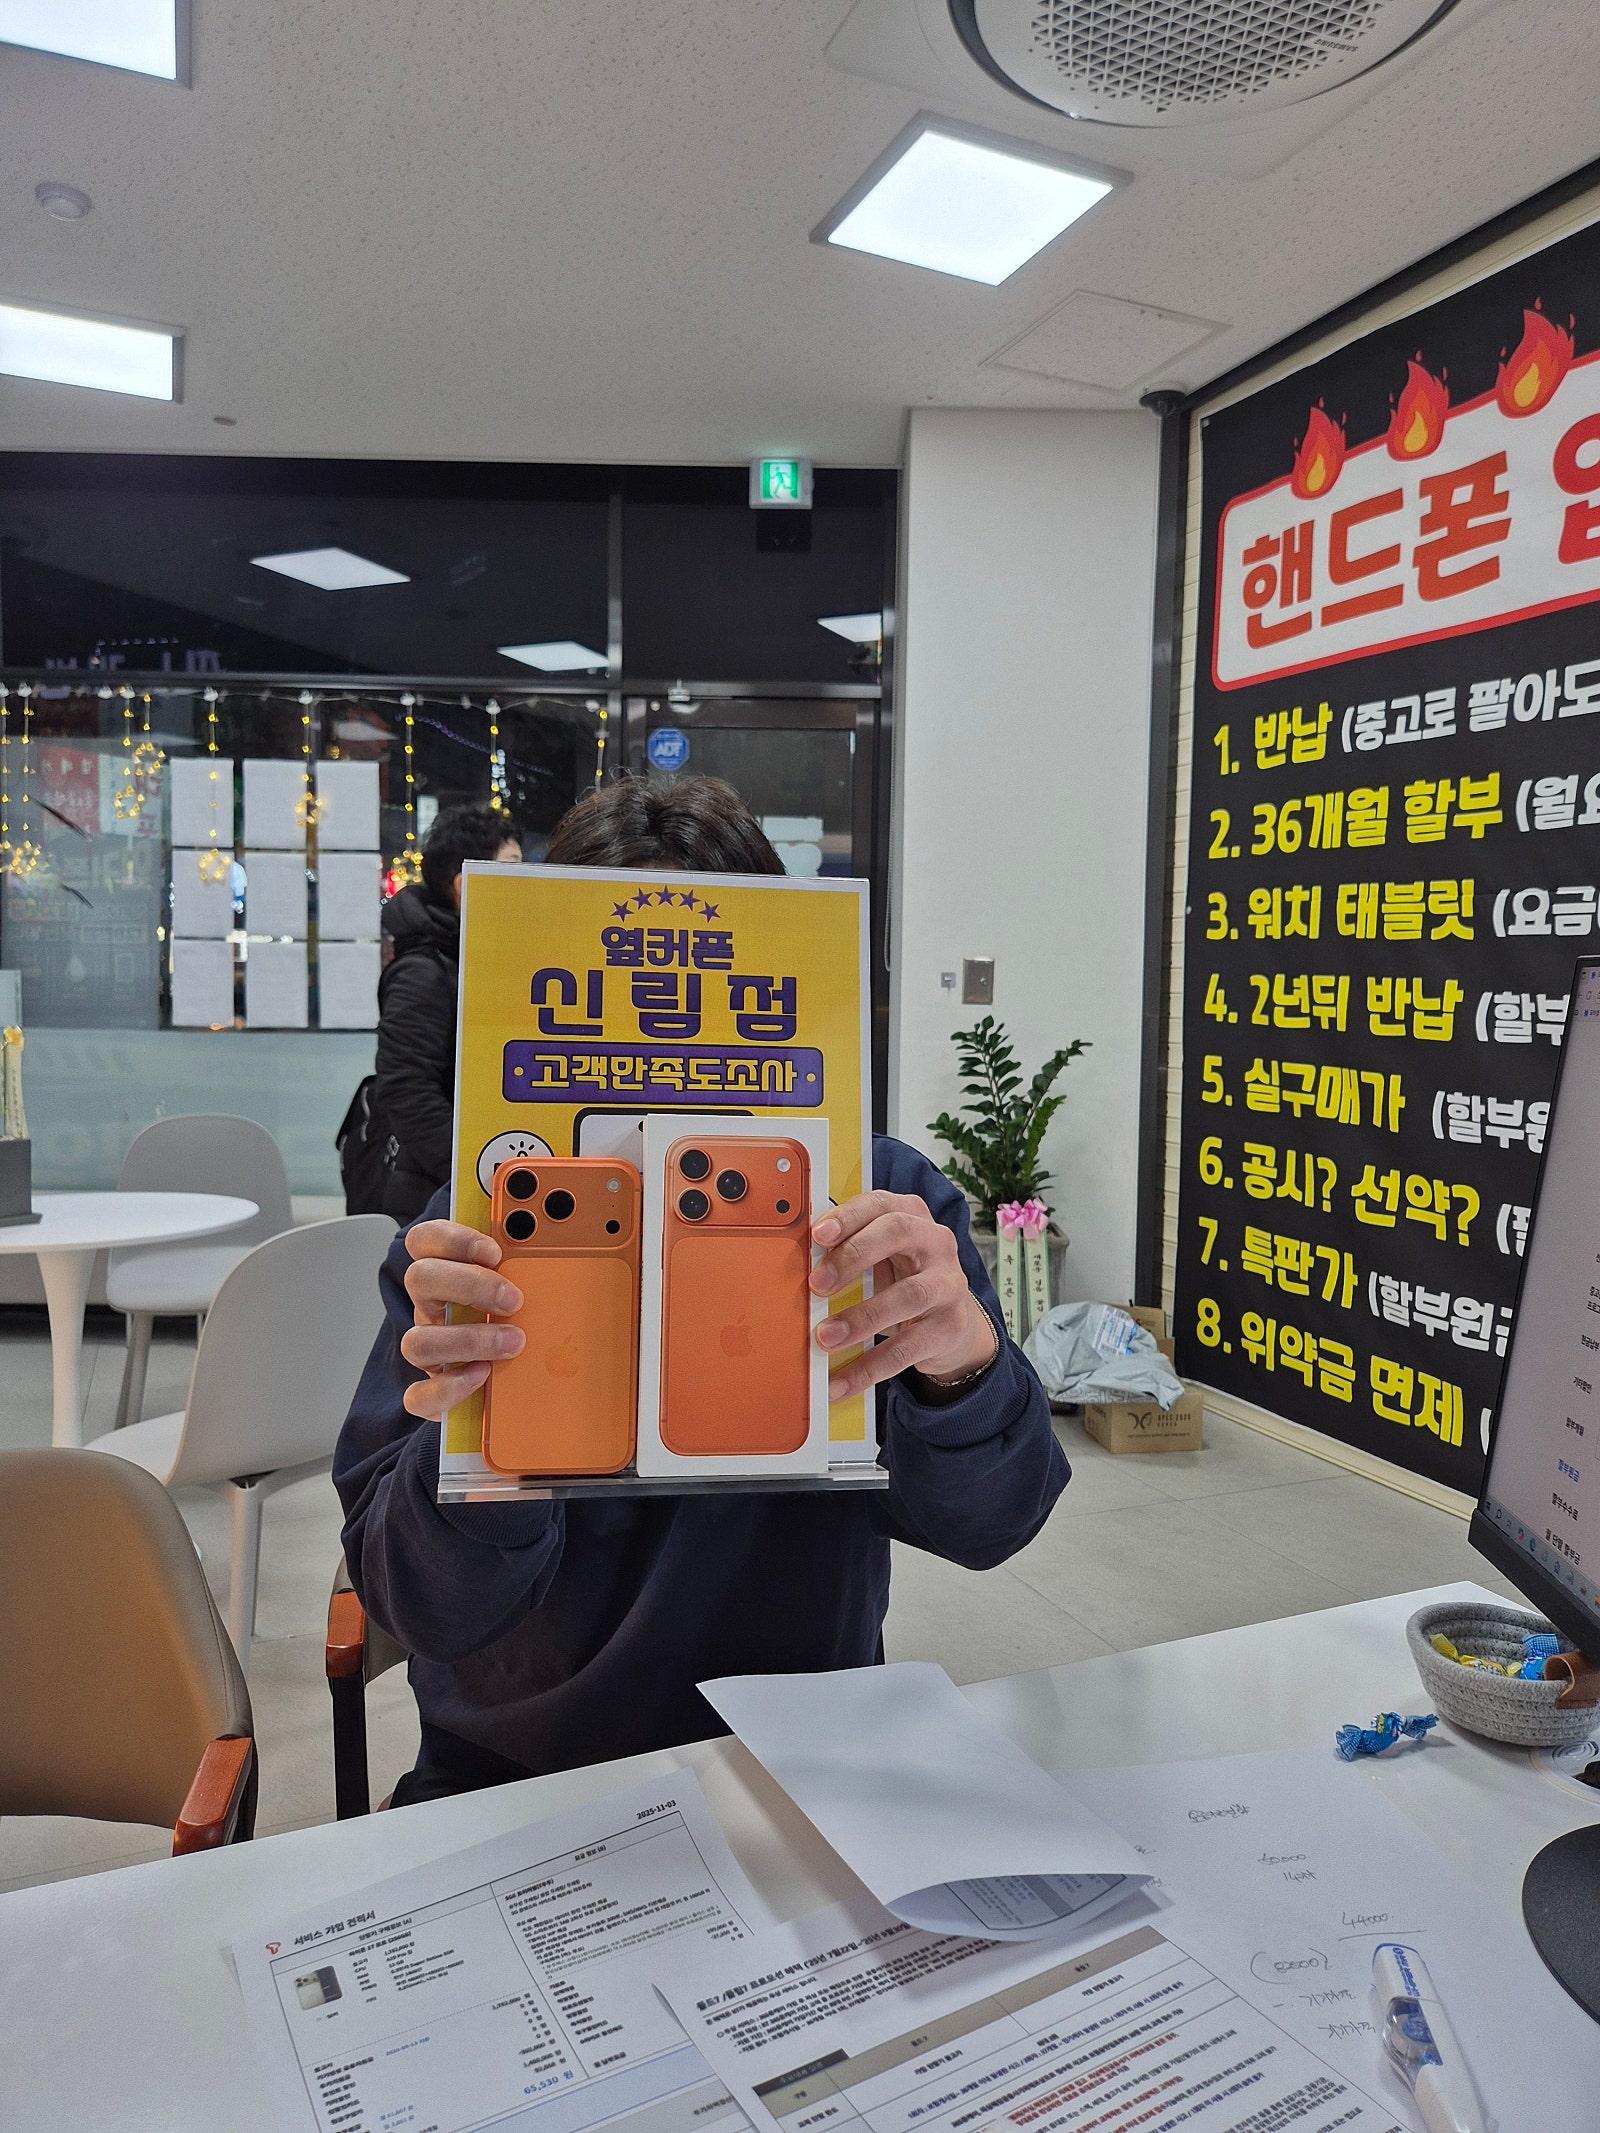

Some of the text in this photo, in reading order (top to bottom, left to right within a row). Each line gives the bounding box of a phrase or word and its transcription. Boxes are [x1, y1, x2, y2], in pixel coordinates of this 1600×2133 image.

[1242, 451, 1512, 650] 핸드폰
[653, 741, 682, 757] ADT
[1213, 659, 1600, 775] 1. 반납 (중고로 팔아도
[1208, 808, 1241, 859] 2.
[1251, 786, 1390, 855] 36개월
[1404, 772, 1503, 844] 할부
[1206, 879, 1600, 941] 3. 워치 태블릿 (요금
[600, 926, 735, 971] 옆커폰
[530, 967, 797, 1042] 신림점
[1204, 973, 1570, 1046] 4. 2년뒤 반납 (할부
[530, 1054, 798, 1094] 고객만족도조사
[1202, 1055, 1233, 1106] 5.
[1245, 1057, 1406, 1133] 실구매가
[1200, 1136, 1234, 1190] 6.
[1241, 1141, 1338, 1213] 공시?
[1351, 1163, 1481, 1247] 선약?
[1198, 1217, 1229, 1272] 7.
[1240, 1224, 1359, 1309] 특판가
[1196, 1298, 1232, 1356] 8.
[1240, 1312, 1357, 1404] 위약금
[1369, 1354, 1464, 1448] 면제
[636, 1800, 676, 1820] 2025-11-03
[294, 1910, 376, 1945] 서비스 가입 견적서
[749, 1970, 785, 1990] 프로모션
[784, 1963, 804, 1974] 혜택
[523, 2076, 559, 2095] 65,530
